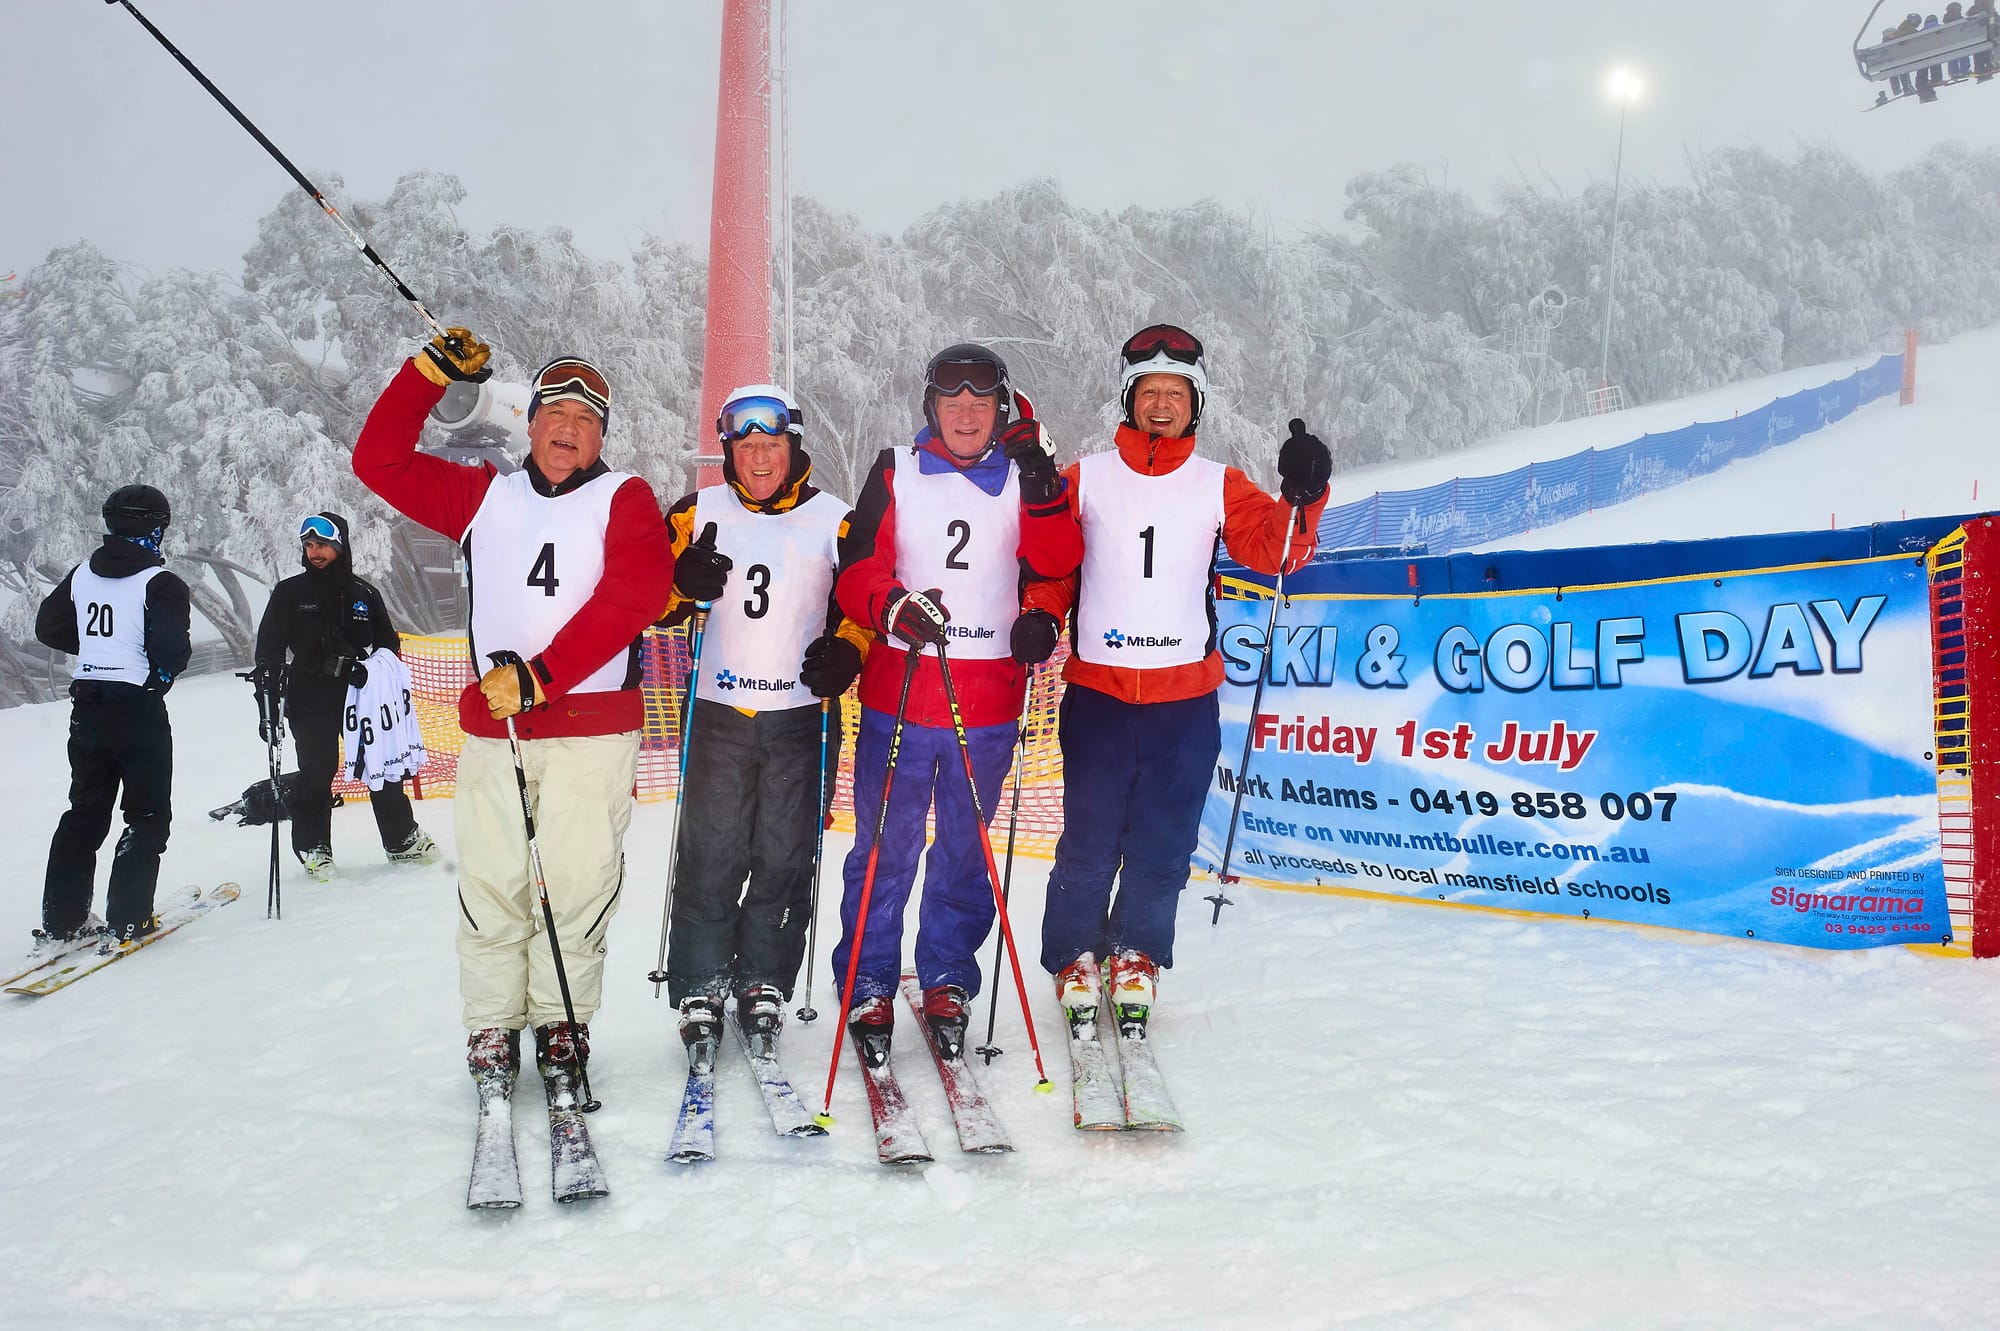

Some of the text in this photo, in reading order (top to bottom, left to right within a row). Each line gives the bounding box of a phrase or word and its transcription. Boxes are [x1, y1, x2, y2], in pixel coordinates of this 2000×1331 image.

[945, 519, 971, 570] 2
[1138, 525, 1155, 578] 1
[526, 542, 559, 597] 4
[744, 564, 771, 619] 3
[917, 596, 940, 618] LEKI
[86, 602, 113, 637] 20
[1221, 595, 1887, 694] SKI & GOLF DAY
[345, 704, 358, 732] 6
[361, 717, 375, 745] 6
[951, 703, 968, 746] LEKI
[1254, 712, 1597, 771] Friday 1st July
[1216, 765, 1678, 822] Mark Adams - 0419 858 007
[1243, 810, 1650, 865] Enter on www.mtbuller.com.au
[1244, 847, 1672, 905] all proceeds to local mansfield schools
[1775, 867, 1925, 882] SIGN DESIGNED AND PRINTED BY
[1886, 886, 1924, 895] Richmond
[1770, 886, 1925, 913] Signarama
[1826, 911, 1841, 920] way
[1841, 911, 1850, 920] to
[1851, 913, 1870, 922] grow
[1871, 914, 1888, 922] your
[1889, 913, 1923, 921] business
[1824, 923, 1844, 934] 03
